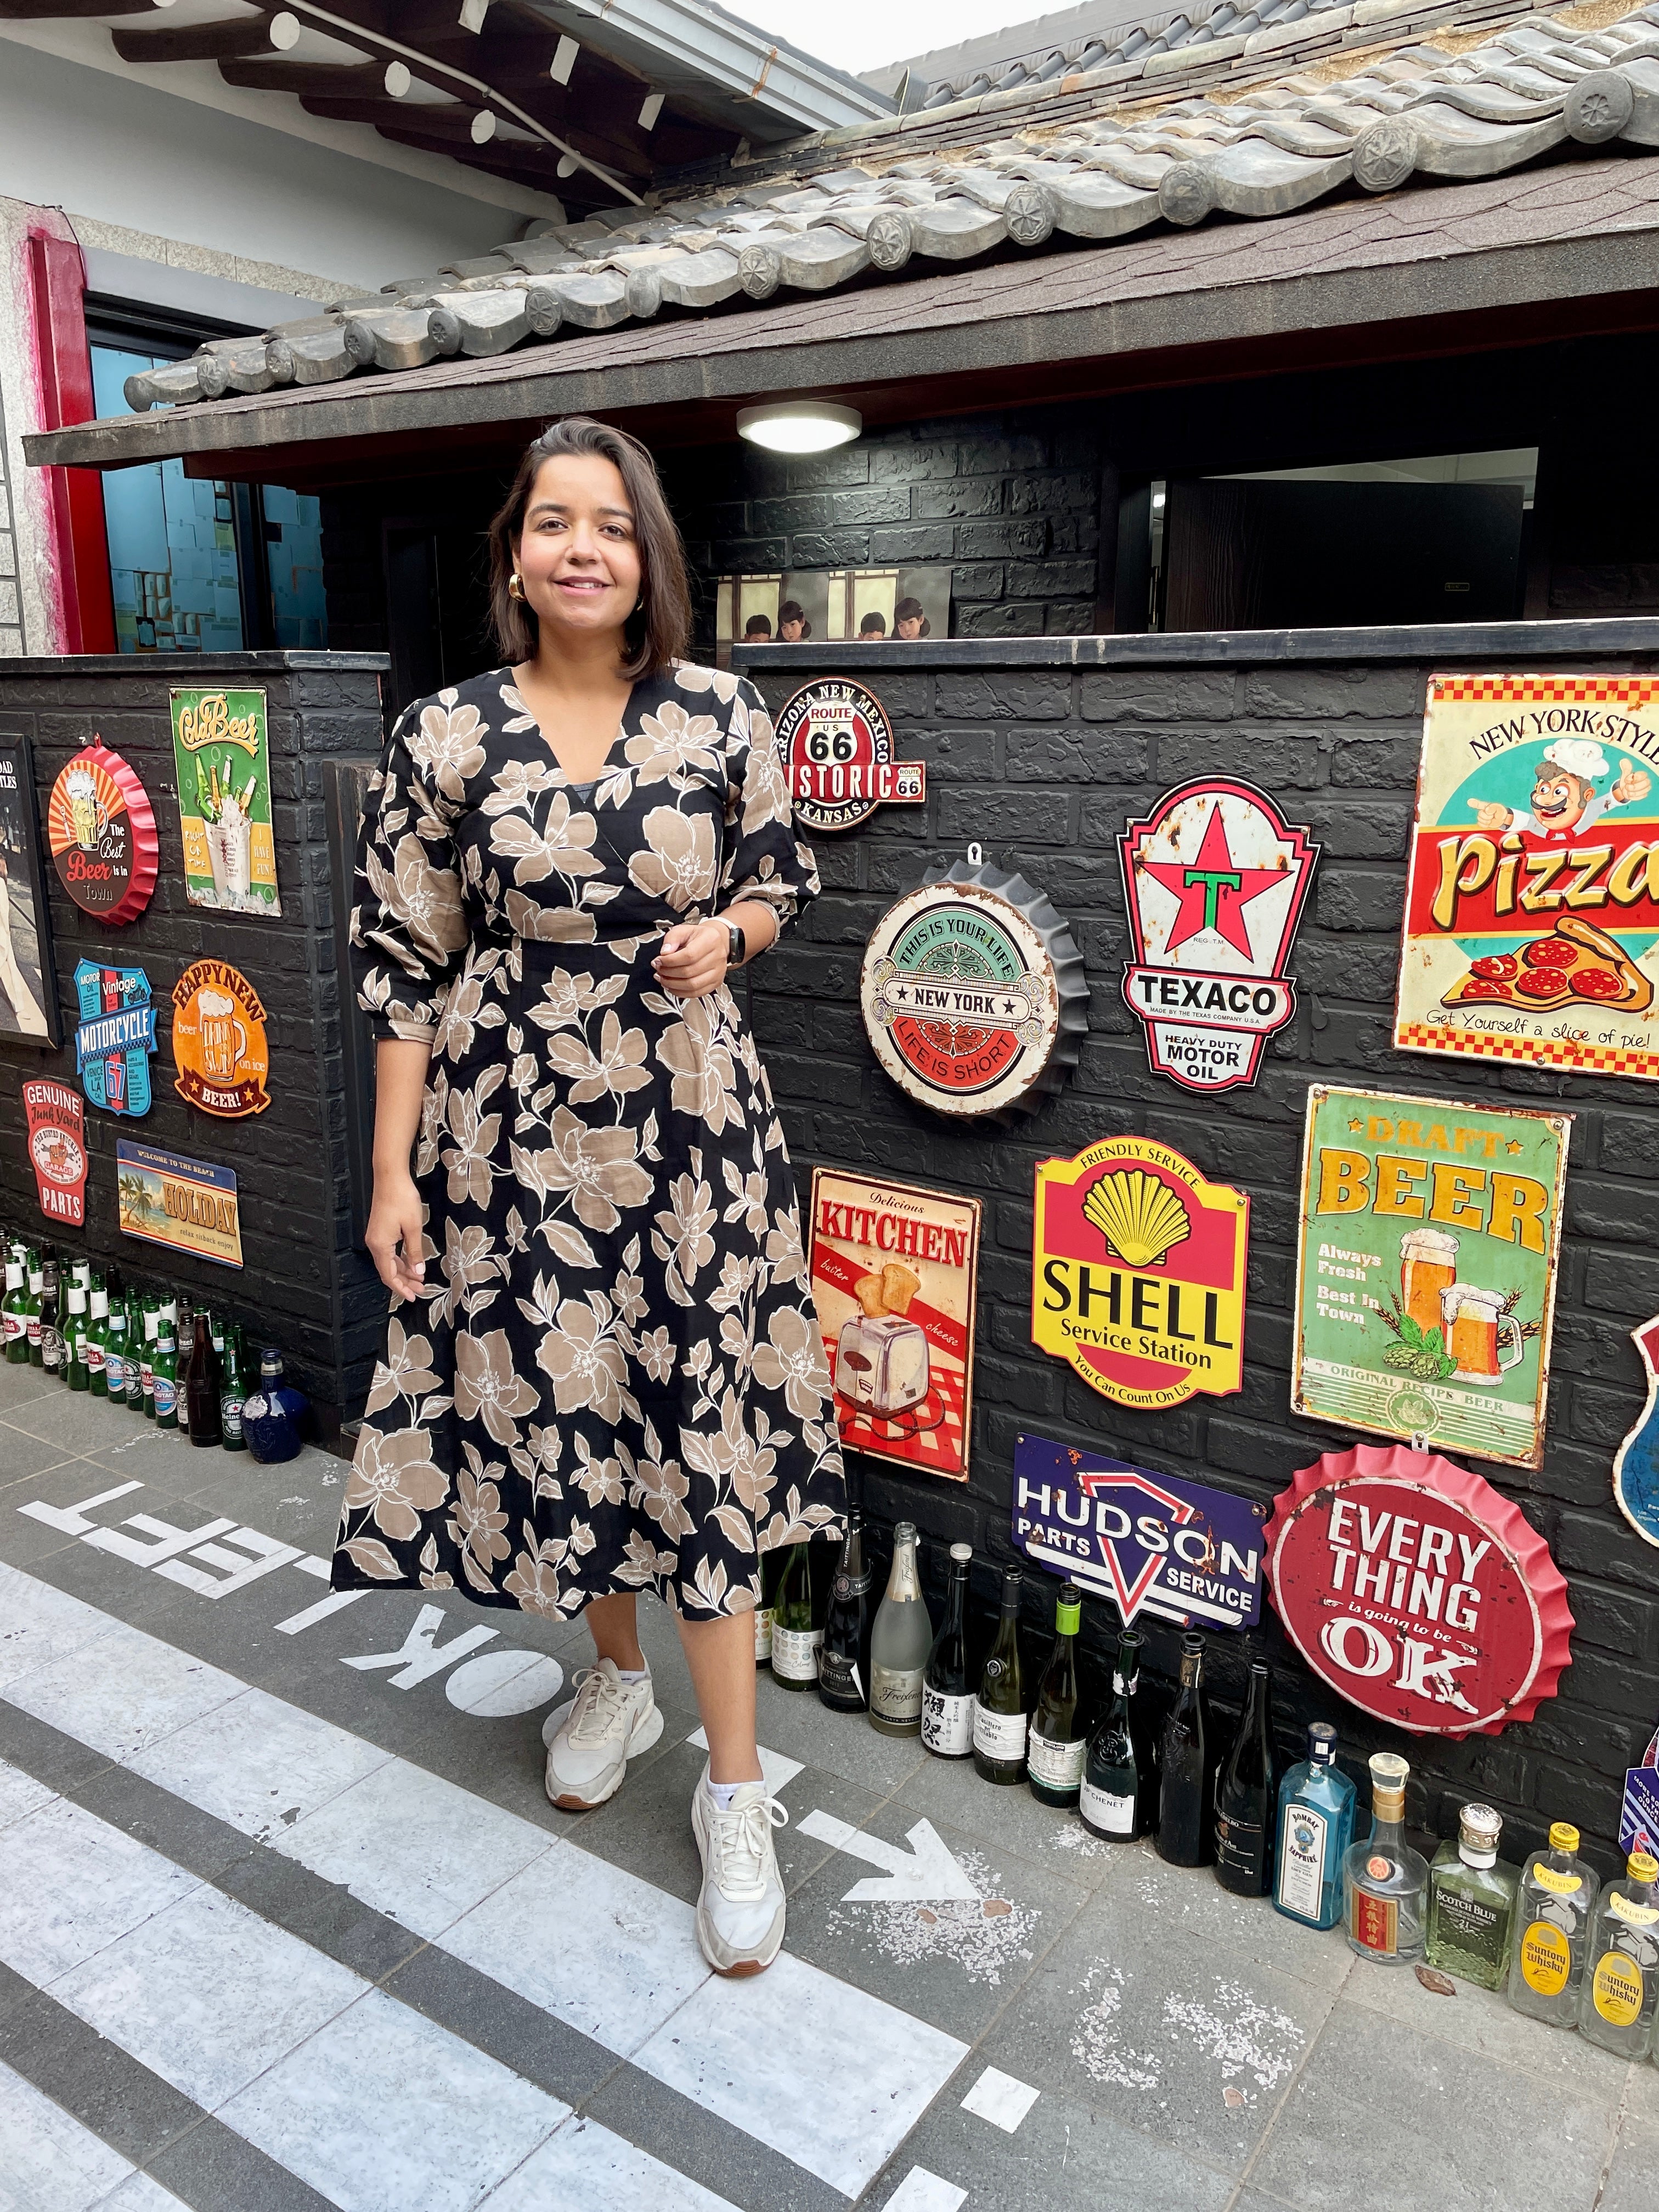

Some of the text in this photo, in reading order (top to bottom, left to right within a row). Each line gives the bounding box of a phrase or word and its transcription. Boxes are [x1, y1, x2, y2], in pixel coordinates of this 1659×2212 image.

[179, 693, 259, 752] Cold Beer
[778, 684, 889, 763] ARIZONA NEW MEXICO
[811, 707, 853, 720] ROUTE
[809, 731, 853, 763] 66
[1469, 714, 1526, 761] NEW
[1530, 708, 1607, 736] YORK
[788, 764, 892, 799] ISTORIC
[898, 780, 919, 795] 66
[801, 801, 863, 824] KANSAS
[110, 823, 125, 837] The
[258, 828, 262, 841] I
[99, 836, 127, 860] Best
[253, 845, 271, 860] HAVE
[66, 850, 128, 882] Beer is in
[83, 884, 113, 902] Town
[1183, 868, 1243, 930] T
[899, 918, 1016, 981] THIS IS YOUR LIFE
[80, 972, 100, 985] MOTOR
[102, 977, 137, 996] Vintage
[173, 963, 265, 1022] HAPPY NEW
[915, 988, 996, 1015] NEW YORK
[1137, 974, 1278, 1017] TEXACO
[80, 1008, 150, 1055] MOTORCYCLE
[178, 1021, 197, 1036] beer
[1213, 1014, 1242, 1023] COMPANY
[1426, 1008, 1651, 1051] Get Yourself a slice of pie!
[203, 1020, 232, 1048] DRINK
[1165, 1034, 1243, 1051] HEAVY DUTY
[896, 1019, 1013, 1081] LIFE IS SHORT
[1167, 1045, 1240, 1068] MOTOR
[86, 1065, 103, 1079] VENICE
[239, 1058, 266, 1072] on ice
[1187, 1064, 1218, 1081] OIL
[105, 1060, 126, 1101] 67
[26, 1085, 80, 1118] GENUINE
[201, 1086, 242, 1108] BEER!
[31, 1106, 81, 1133] Junk Yard
[1365, 1114, 1505, 1159] DRAFT
[44, 1161, 73, 1176] GARAGE
[137, 1149, 168, 1164] WELCOME
[168, 1158, 178, 1167] TO
[178, 1161, 192, 1172] THE
[1079, 1143, 1201, 1189] FRIENDLY SERVICE
[42, 1186, 81, 1220] PARTS
[162, 1181, 236, 1237] HOLIDAY
[868, 1191, 925, 1214] Delicious
[1316, 1147, 1549, 1255] BEER
[179, 1228, 194, 1238] relax
[217, 1239, 234, 1251] enjoy
[820, 1199, 969, 1268] KITCHEN
[1317, 1242, 1382, 1268] Always
[819, 1258, 849, 1283] butter
[1317, 1260, 1367, 1283] Fresh
[1042, 1259, 1234, 1351] SHELL
[1317, 1284, 1380, 1310] Best In
[1316, 1302, 1365, 1325] Town
[925, 1321, 959, 1348] cheese
[1060, 1318, 1212, 1370] Service Station
[1075, 1355, 1191, 1404] You Can Count On Us
[1330, 1364, 1504, 1413] ORIGINAL RECIPE BEER
[1018, 1476, 1258, 1584] HUDSON
[1018, 1517, 1091, 1557] PARTS
[1327, 1496, 1493, 1584] EVERY
[1166, 1566, 1254, 1613] SERVICE
[1328, 1543, 1482, 1634] THING
[1347, 1600, 1452, 1644] is going to be
[1319, 1616, 1480, 1715] OK
[1633, 1775, 1651, 1796] MORE
[1642, 1792, 1650, 1804] TO
[1091, 1792, 1125, 1809] CHENET
[1638, 1796, 1658, 1824] OUNCE
[1291, 1813, 1320, 1831] BOMBAY
[1288, 1844, 1319, 1864] SAPPHIRE
[1538, 1872, 1573, 1889] KAKUBIN
[1436, 1890, 1472, 1912] SCOTCH
[1473, 1904, 1497, 1922] BLUE
[1615, 1901, 1650, 1921] KAKUBIN
[1525, 1942, 1566, 1966] Suntory
[1526, 1951, 1564, 1975] Whisky
[1598, 1979, 1637, 2006] Whisky
[1599, 1971, 1640, 1995] Suntory
